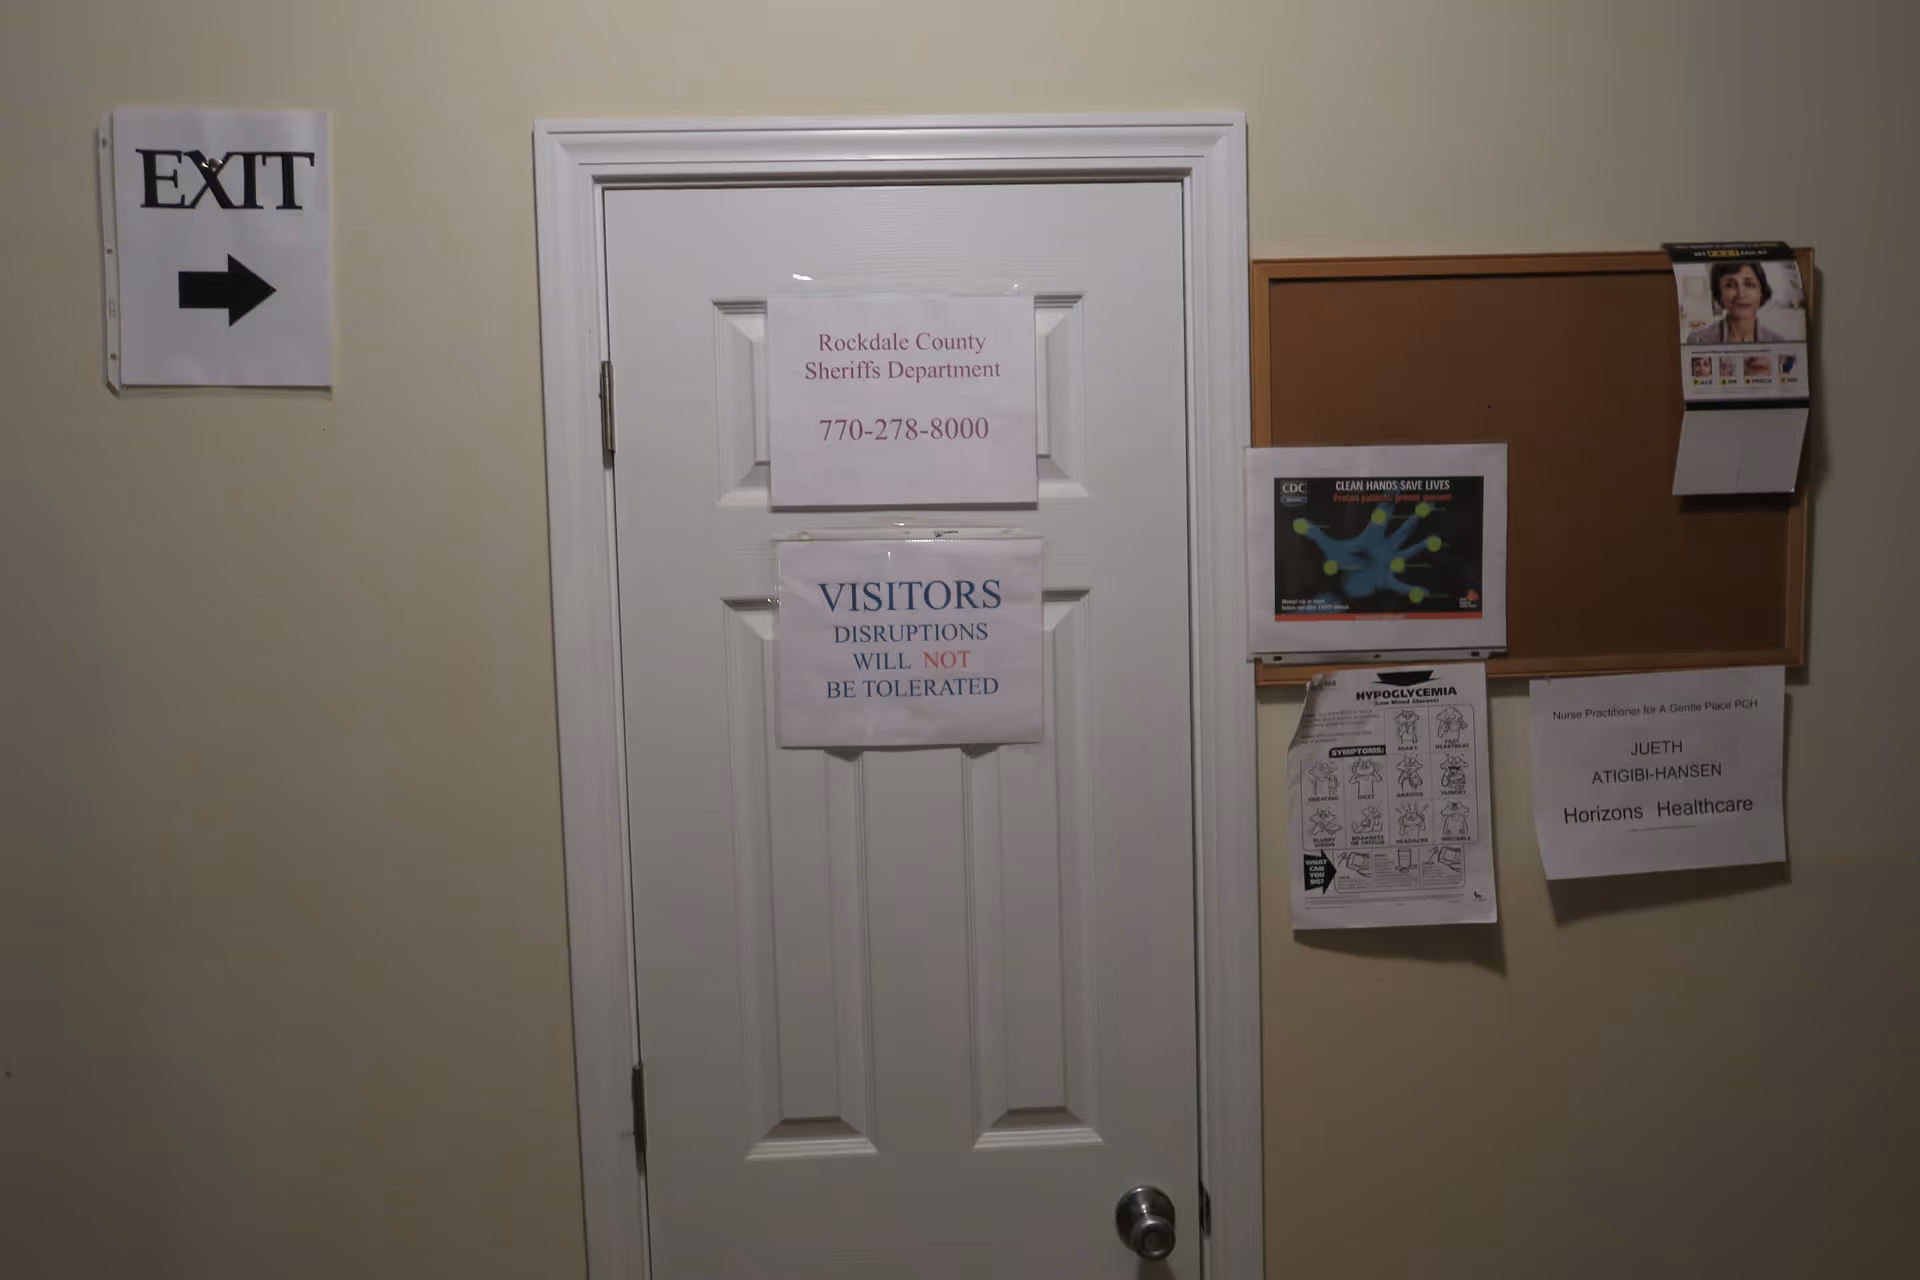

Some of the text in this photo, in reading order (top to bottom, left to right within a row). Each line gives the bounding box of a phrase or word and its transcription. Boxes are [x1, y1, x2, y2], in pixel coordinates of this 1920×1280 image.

[135, 147, 315, 210] EXIT
[818, 332, 987, 354] Rockdale County
[804, 360, 1001, 383] Sheriffs Department
[819, 416, 989, 442] 770-278-8000
[1282, 482, 1305, 494] CDC
[1335, 479, 1451, 491] CLEAN HANDS SAVE LIVES
[817, 578, 1002, 613] VISITORS
[833, 622, 989, 644] DISRUPTIONS
[852, 650, 972, 671] WILL NOT
[826, 677, 999, 699] BE TOLERATED
[1356, 686, 1458, 701] HYPOGLYCEMIA
[1552, 698, 1759, 721] Nurse Practitioner for A Gentle Place PCH
[1331, 746, 1385, 756] SYMPTOMS:
[1630, 740, 1684, 756] JUETH
[1591, 763, 1723, 785] ATIGIBI-HANSEN
[1563, 798, 1754, 825] Horizons Healthcare
